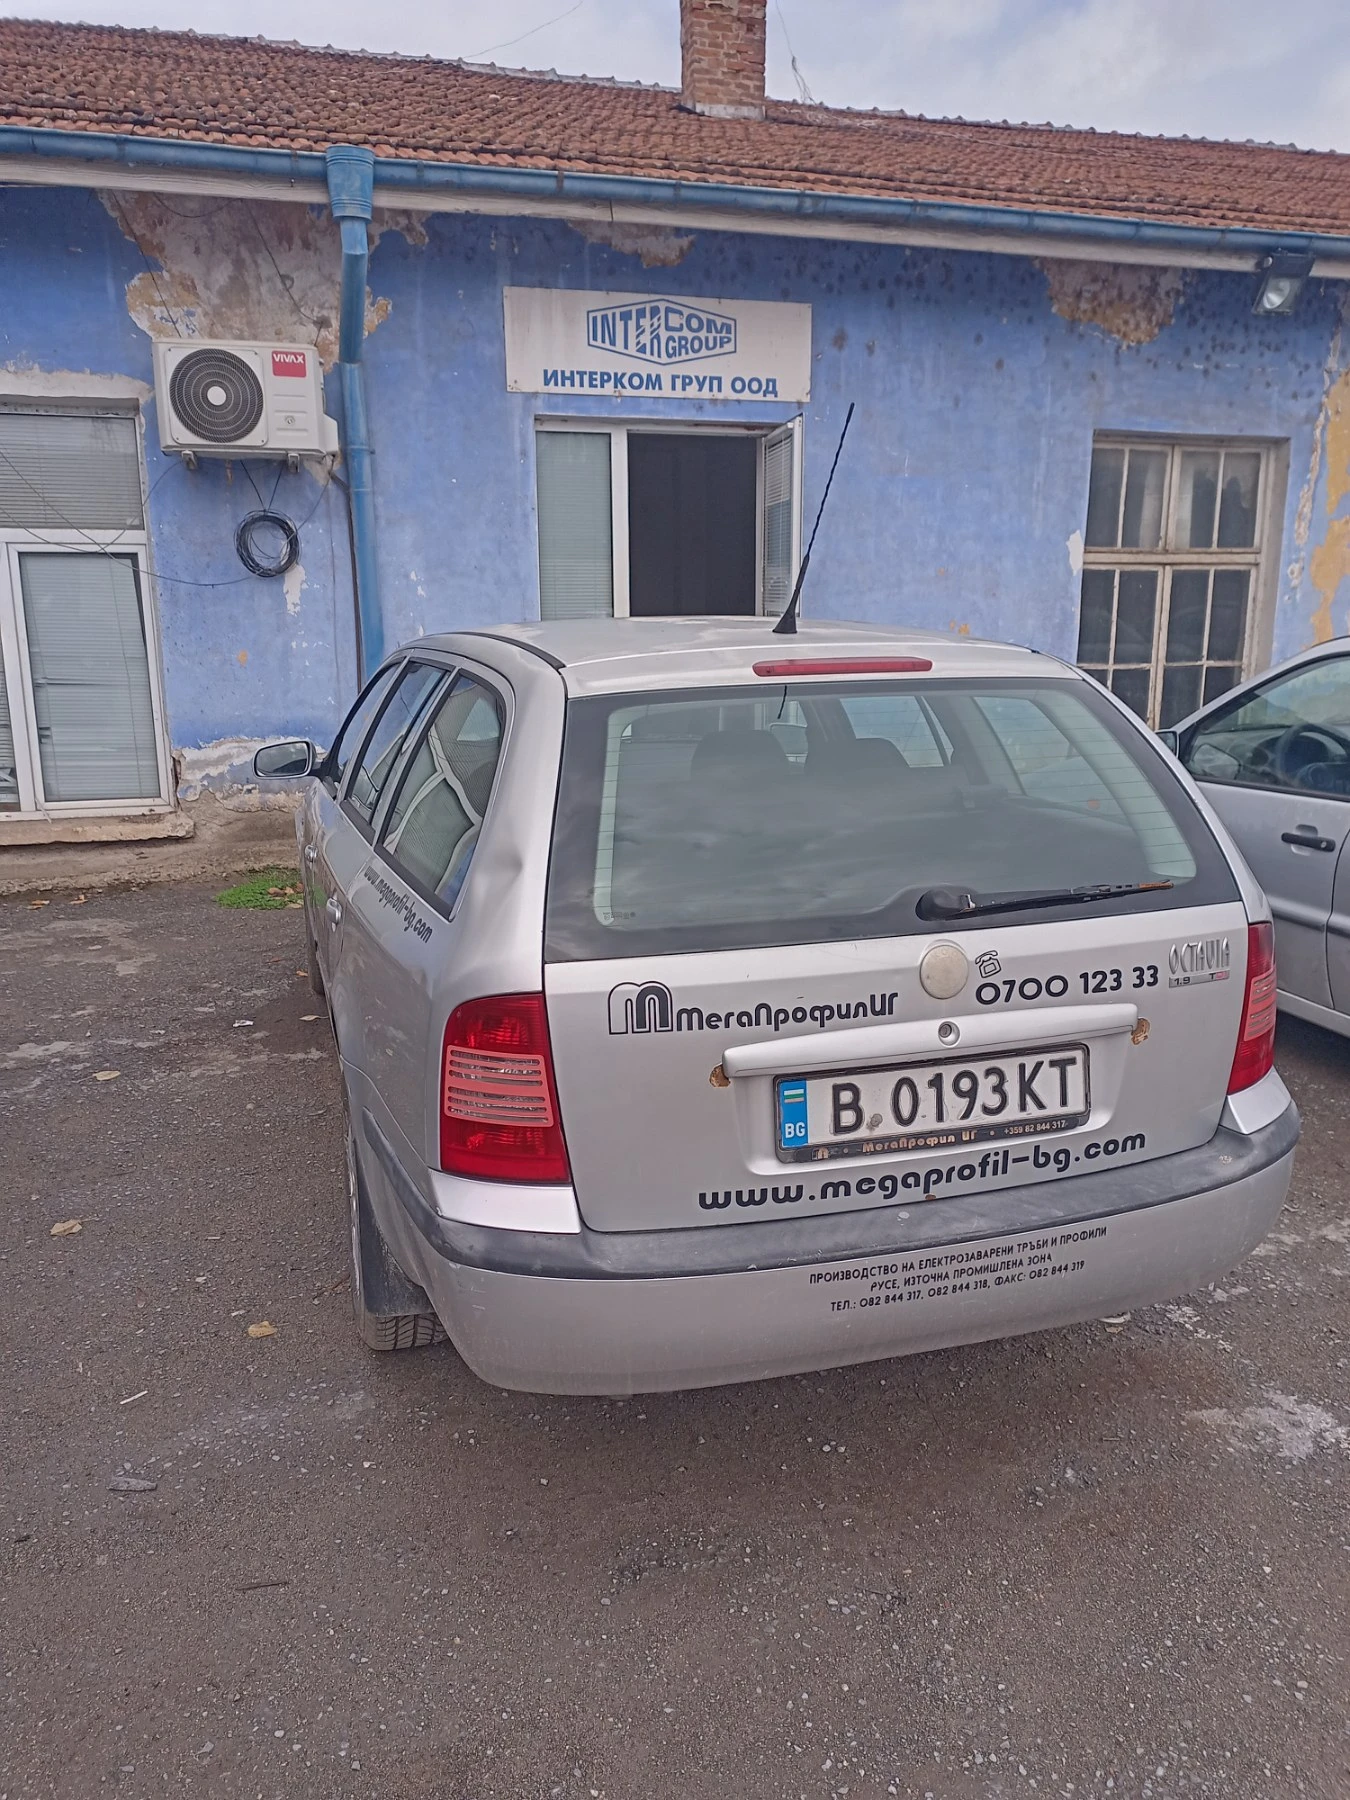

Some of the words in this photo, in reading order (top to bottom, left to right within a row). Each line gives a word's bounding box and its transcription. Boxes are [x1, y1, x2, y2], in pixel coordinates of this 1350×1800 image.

[273, 353, 304, 364] VIVAX
[665, 335, 732, 359] GROUP
[543, 369, 663, 391] ИНТЕРКОМ
[671, 374, 722, 393] ГРУП
[731, 376, 778, 398] ООД
[364, 865, 433, 943] www.megaprofil-bg.com
[1168, 937, 1230, 975] OCTAVIA
[975, 974, 1068, 1006] 0700
[1079, 968, 1122, 995] 123
[1132, 964, 1159, 989] 33
[1174, 976, 1191, 986] 1.9
[785, 1121, 806, 1139] BG
[1004, 1127, 1023, 1135] +359
[1025, 1124, 1035, 1133] 82
[1036, 1122, 1050, 1131] 844
[1052, 1120, 1066, 1129] 317
[699, 1132, 1146, 1211] www.megaprofil-bg.com
[809, 1263, 899, 1284] ПРОИЗВОДСТВО
[901, 1262, 915, 1273] НА
[918, 1245, 1014, 1270] ЕЛЕКТРОЗАВАРЕНИ
[1016, 1238, 1049, 1253] ТРЪБИ
[1050, 1237, 1058, 1248] И
[1059, 1226, 1107, 1246] ПРОФИЛИ
[903, 1269, 950, 1288] ИЗТОЧНА
[952, 1259, 1024, 1280] ПРОМИШЛЕНА
[1027, 1252, 1053, 1267] ЗОНА
[859, 1296, 881, 1308] 082
[884, 1292, 904, 1304] 844
[927, 1285, 949, 1298] 082
[951, 1281, 970, 1294] 844
[973, 1278, 991, 1290] 318,
[994, 1271, 1027, 1286] ФАКС:
[1029, 1267, 1049, 1280] 082
[1051, 1263, 1069, 1276] 844
[1071, 1260, 1086, 1272] 319
